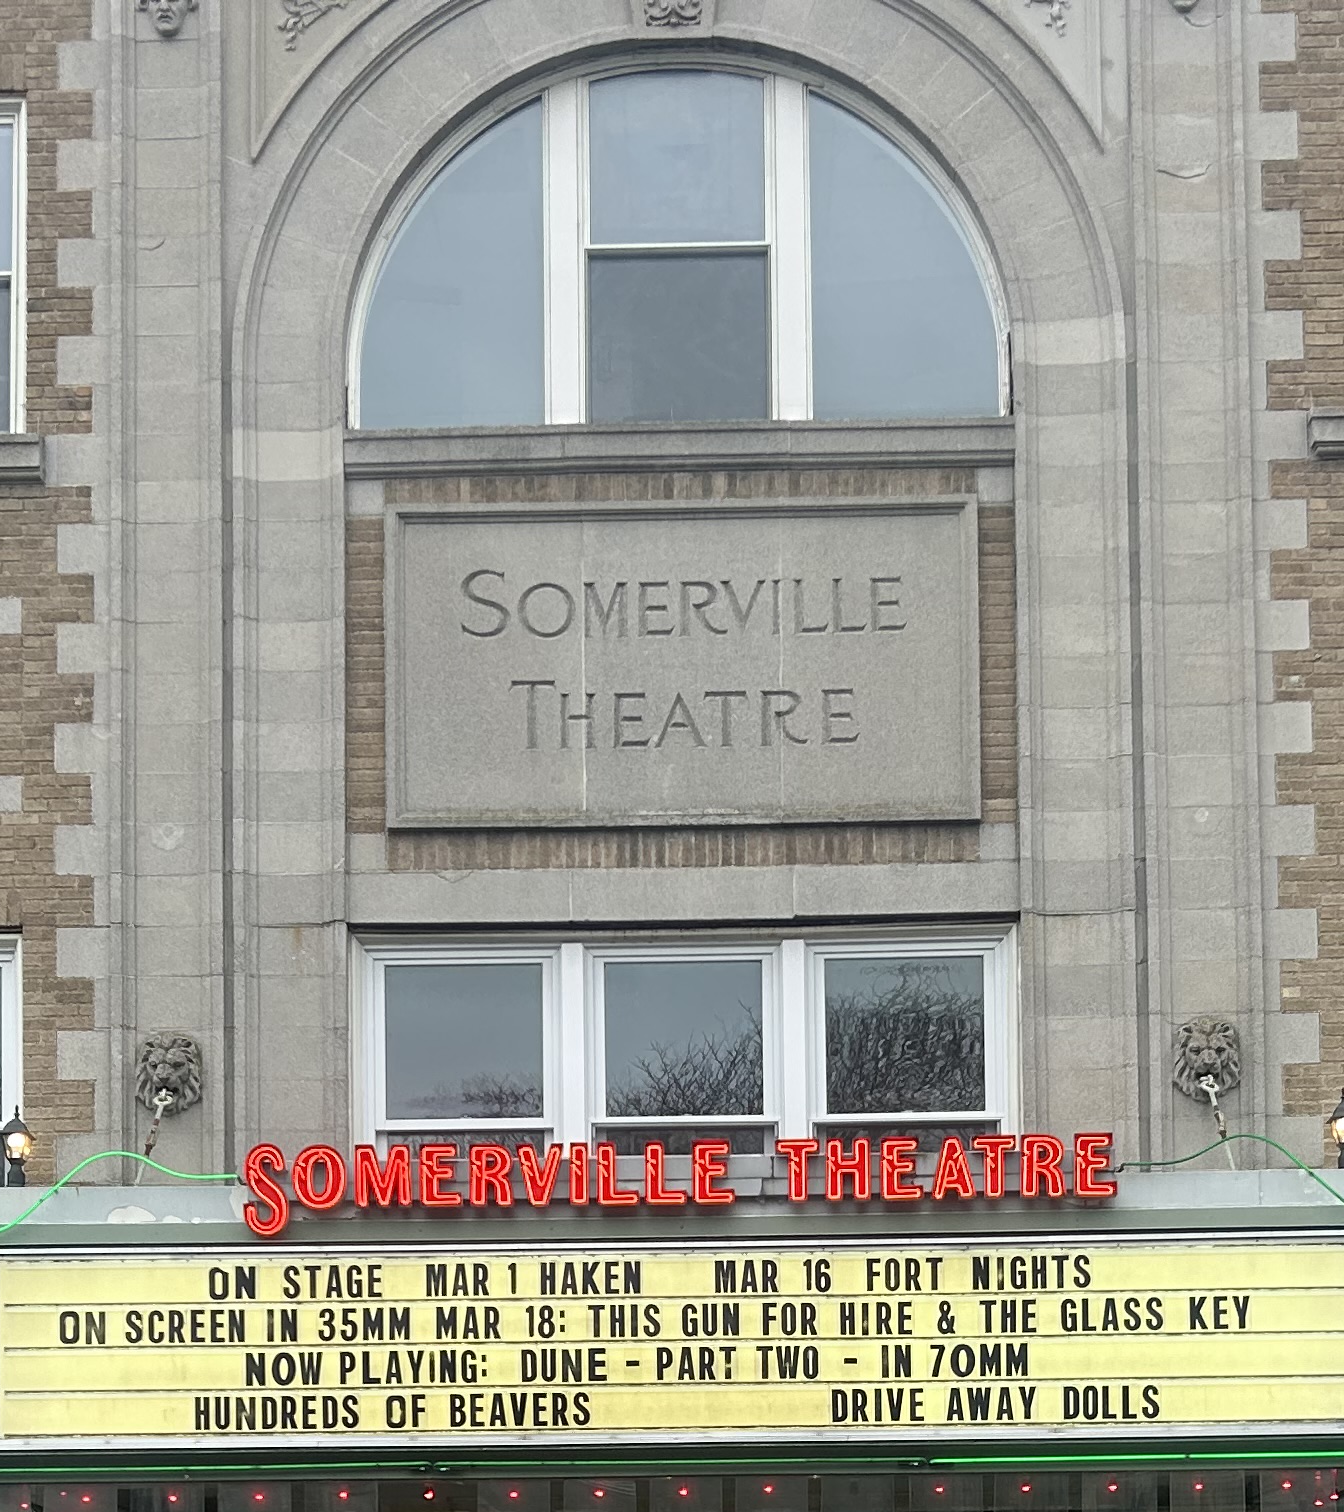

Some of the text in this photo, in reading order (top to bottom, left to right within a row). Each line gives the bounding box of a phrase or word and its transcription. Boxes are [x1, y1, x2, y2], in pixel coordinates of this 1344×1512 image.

[459, 569, 908, 639] SOMERVILLE
[509, 678, 861, 750] THEATRE
[243, 1131, 1117, 1236] SOMERVILLE THEATRE
[209, 1255, 1090, 1301] ON STAGE MAR 1 HAKEN MAR 16 FORT NIGHTS
[60, 1296, 1249, 1346] ON SCREEN IN 35MM MAR 18: THIS GUN FOR HIRE & THE GLASS KEY
[246, 1352, 322, 1390] NOW
[340, 1350, 492, 1387] PLAYING:
[522, 1348, 607, 1382] DUNE
[657, 1347, 736, 1380] PART
[757, 1346, 818, 1379] TWO
[882, 1345, 911, 1378] IN
[931, 1343, 1027, 1377] 70MM
[196, 1385, 1159, 1433] HUNDREDS OF BEAVERS DRIVE AWAY DOLLS
